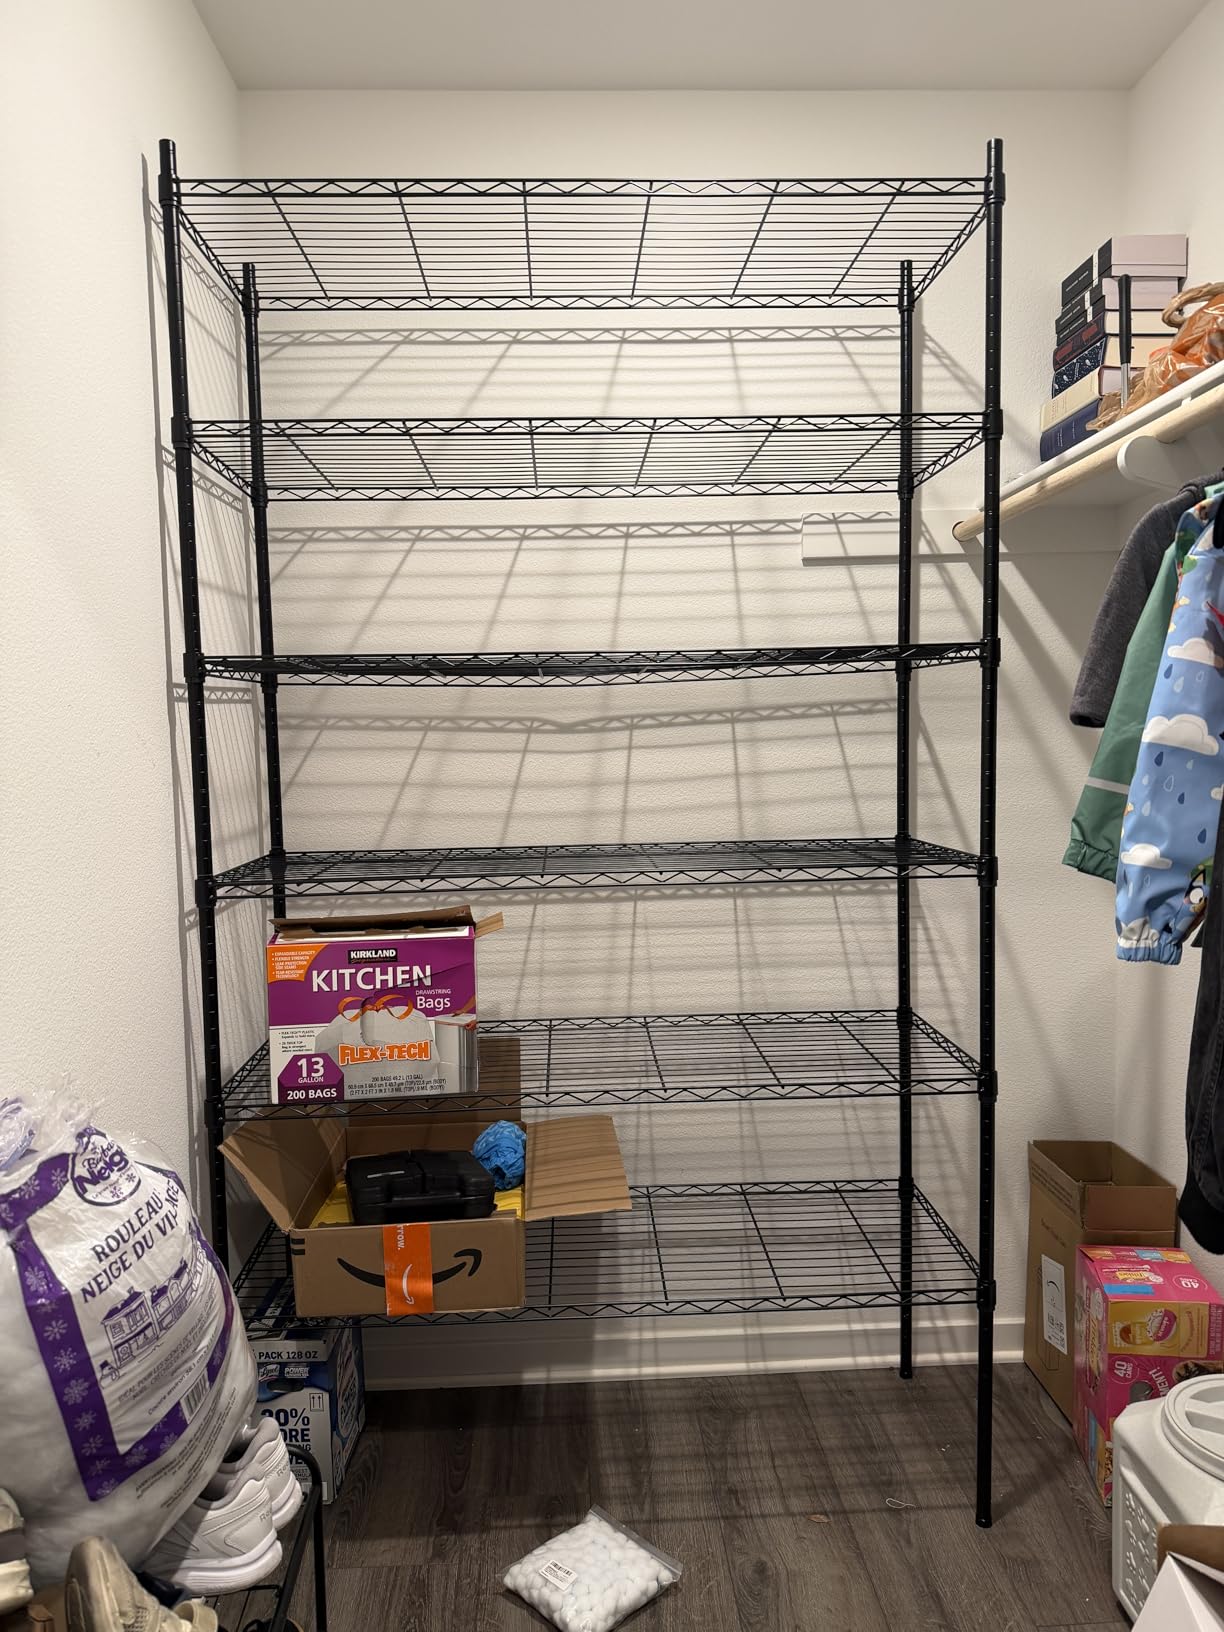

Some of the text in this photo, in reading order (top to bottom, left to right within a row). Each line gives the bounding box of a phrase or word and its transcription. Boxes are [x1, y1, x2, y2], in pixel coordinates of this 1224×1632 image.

[350, 949, 396, 959] KIRKLAND
[312, 965, 432, 992] KITCHEN
[416, 988, 451, 996] DRAWSTRING
[416, 996, 451, 1011] Bags
[338, 1040, 431, 1066] FLEX-TECH
[297, 1057, 324, 1078] 13
[287, 1088, 337, 1100] 200 BAGS
[80, 1251, 132, 1303] NEIGE
[133, 1230, 155, 1262] DU
[1181, 1280, 1199, 1288] 40
[258, 1351, 283, 1360] PACK
[286, 1351, 303, 1359] 128
[305, 1351, 318, 1359] OZ
[284, 1367, 309, 1377] POWER
[1114, 1361, 1126, 1378] 40
[1148, 1366, 1170, 1398] MENT!
